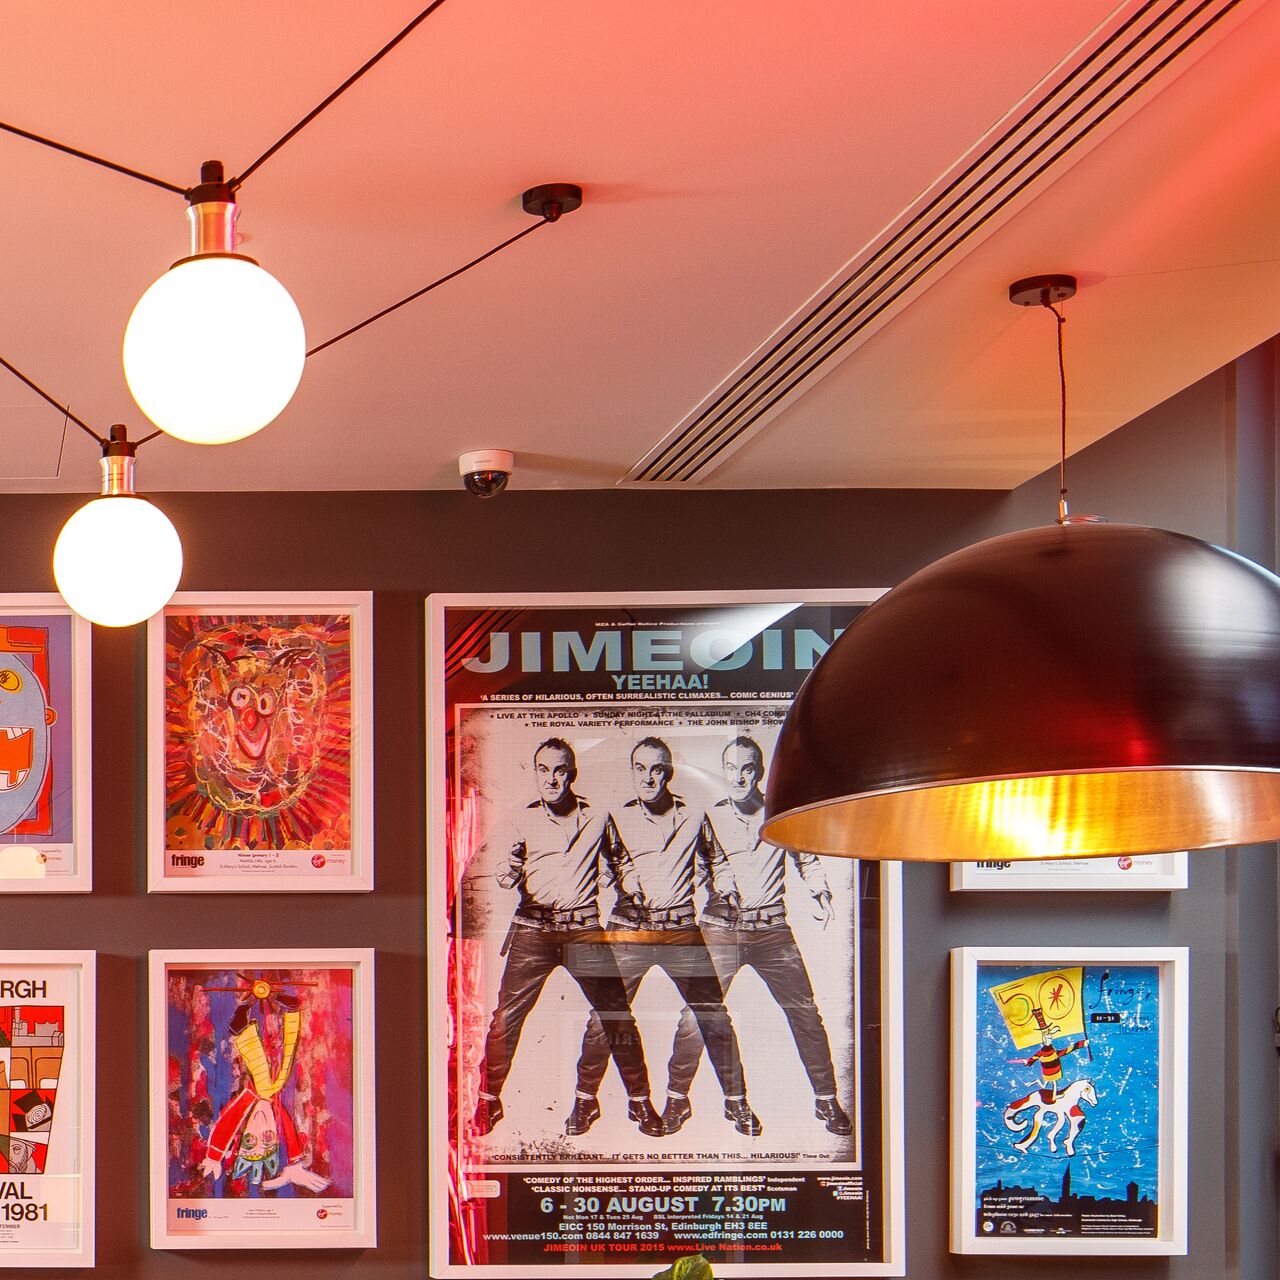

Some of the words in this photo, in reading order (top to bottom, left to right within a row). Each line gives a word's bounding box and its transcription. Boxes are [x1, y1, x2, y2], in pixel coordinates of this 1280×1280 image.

[612, 674, 709, 690] YEEHAA!
[535, 693, 584, 701] HILARIOUS,
[616, 692, 677, 700] SURREALISTIC
[679, 692, 728, 700] CLIMAXES...
[760, 691, 794, 699] GENIUS'
[171, 854, 205, 869] fringe
[540, 1197, 554, 1213] 6
[573, 1197, 600, 1213] 30
[606, 1196, 700, 1213] AUGUST
[711, 1195, 786, 1212] 7.30PM
[1, 1202, 48, 1221] 1981
[176, 1207, 208, 1220] fringe
[559, 1223, 584, 1231] EICC
[586, 1223, 605, 1231] 150
[607, 1223, 652, 1231] Morrison
[654, 1222, 669, 1232] St,
[671, 1222, 722, 1232] Edinburgh
[724, 1222, 745, 1230] EH3
[747, 1222, 768, 1230] 8EE
[483, 1232, 584, 1241] www.venue150.com
[585, 1232, 612, 1240] 0844
[613, 1232, 633, 1240] 847
[634, 1231, 660, 1240] 1639
[674, 1231, 768, 1241] www.edfringe.com
[770, 1231, 795, 1239] 0131
[797, 1231, 817, 1239] 226
[819, 1230, 844, 1239] 0000
[543, 1244, 587, 1252] JIMEOIN
[590, 1244, 606, 1252] UK
[667, 1243, 717, 1251] www.Live
[719, 1243, 783, 1251] Nation.co.uk
